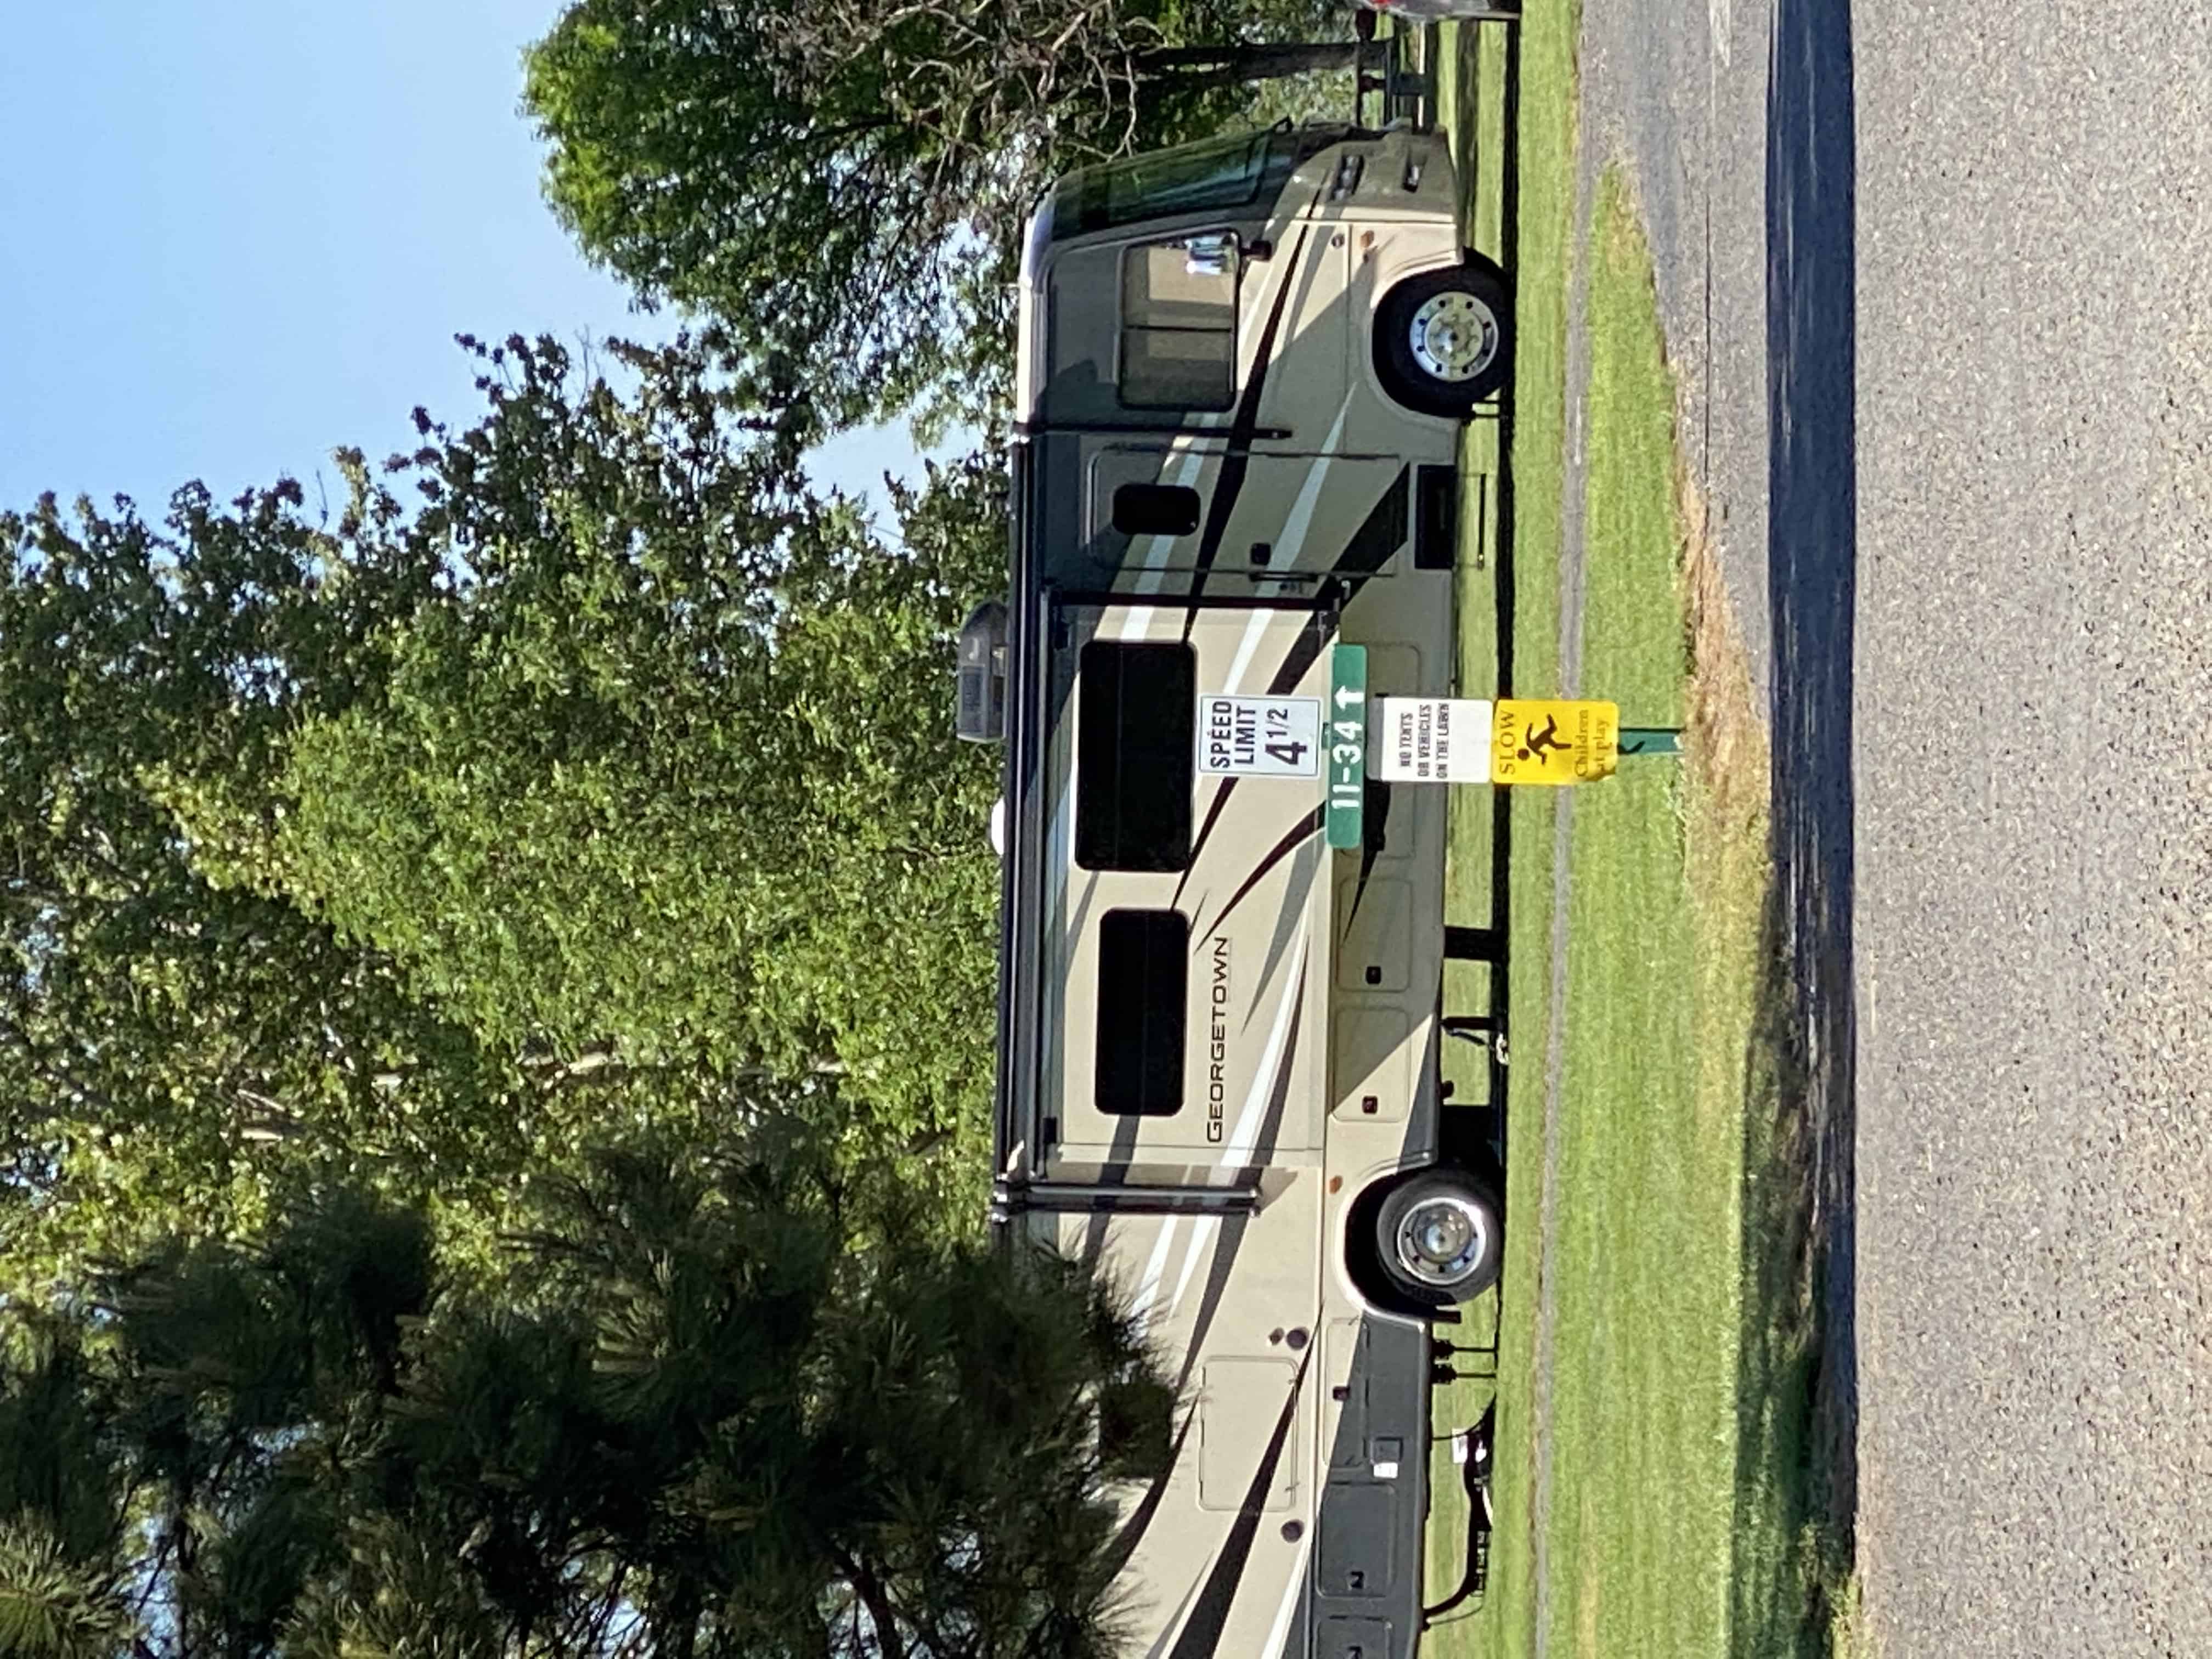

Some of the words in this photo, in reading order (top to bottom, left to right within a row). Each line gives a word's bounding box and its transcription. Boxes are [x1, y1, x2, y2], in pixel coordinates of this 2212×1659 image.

[1210, 701, 1231, 768] SPEED
[1234, 706, 1256, 764] LIMIT
[1400, 713, 1413, 748] TENTS
[1418, 704, 1431, 758] VEHICLES
[1437, 703, 1449, 736] LAWN
[1593, 720, 1612, 751] play
[1400, 752, 1412, 766] NO
[1436, 739, 1448, 760] THE
[1499, 710, 1515, 775] SLOW
[1575, 709, 1588, 777] Children
[1331, 720, 1361, 810] 11-34
[1418, 762, 1429, 776] OR
[1436, 764, 1448, 778] ON
[1595, 757, 1606, 773] at
[1207, 937, 1228, 1143] GEORGETOWN
